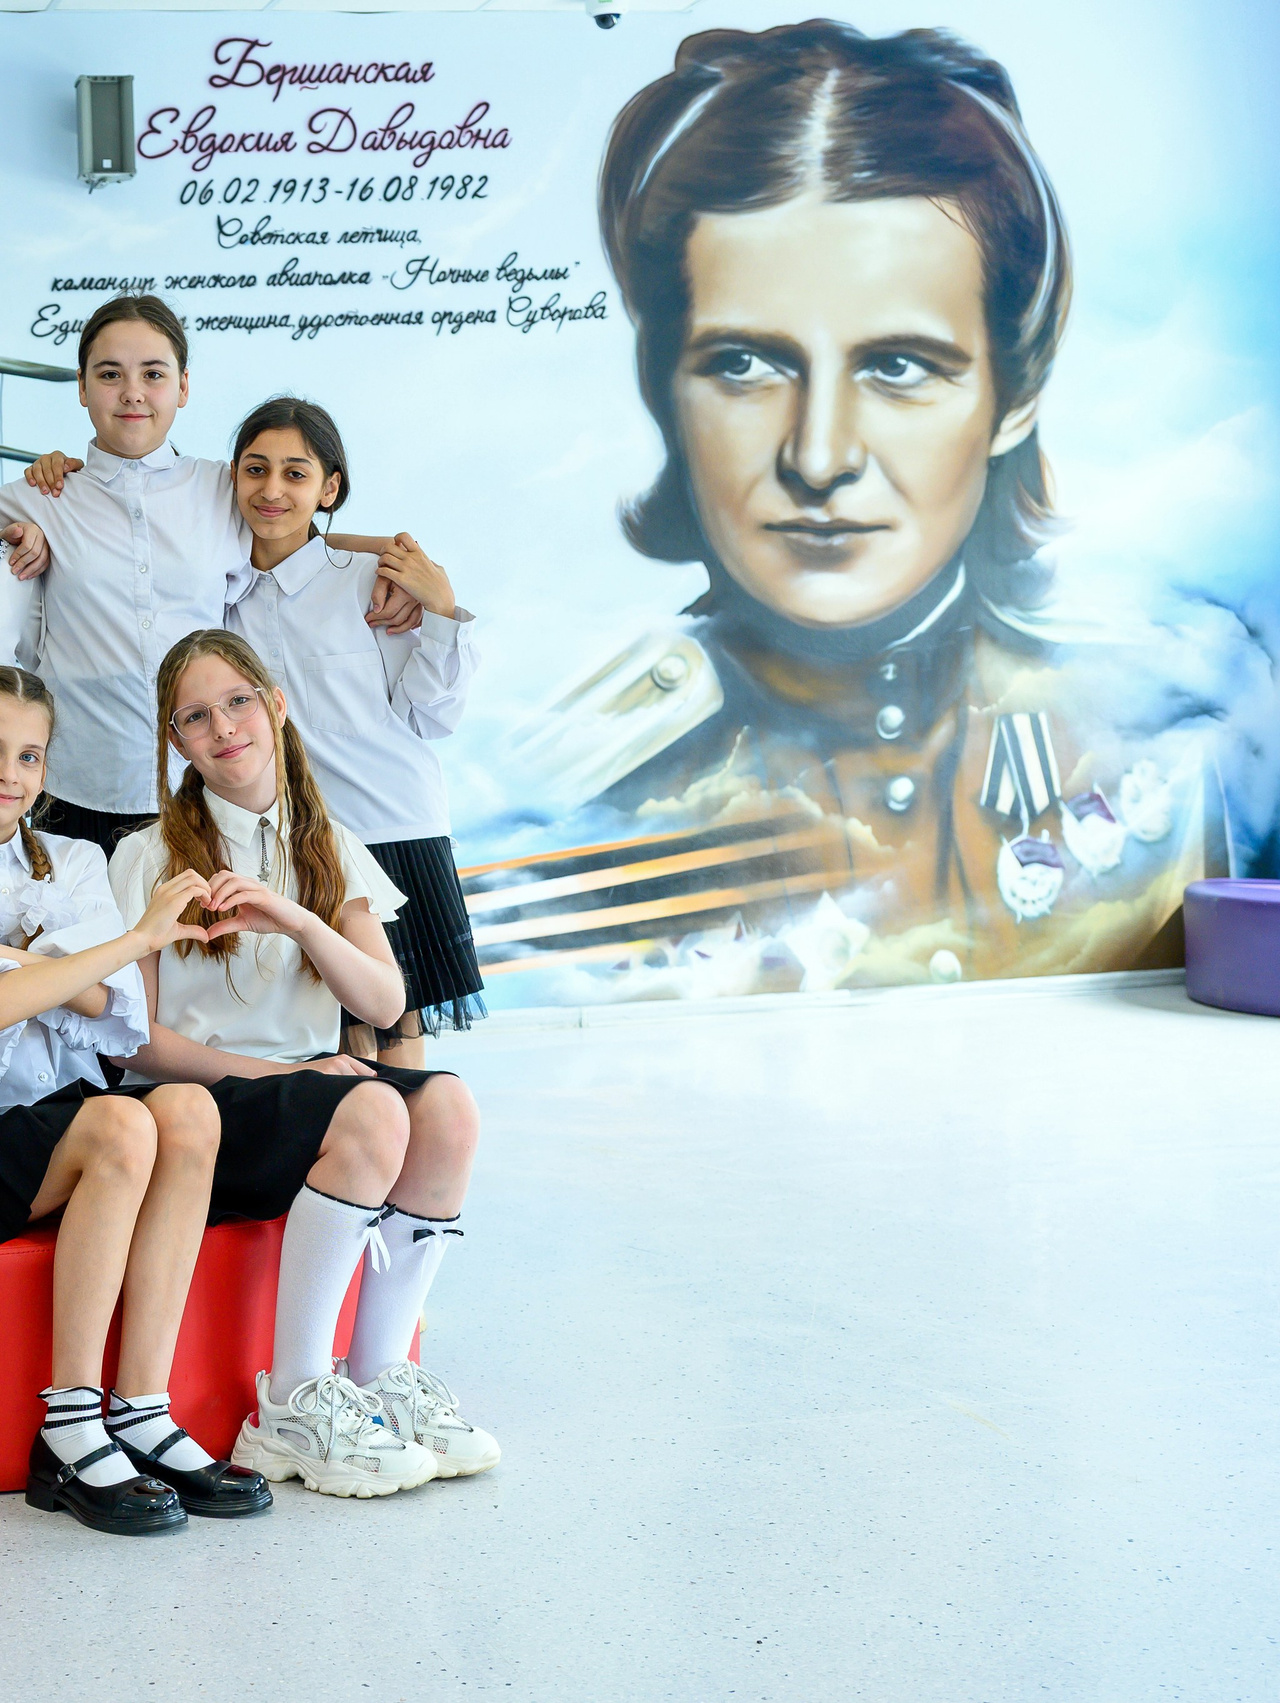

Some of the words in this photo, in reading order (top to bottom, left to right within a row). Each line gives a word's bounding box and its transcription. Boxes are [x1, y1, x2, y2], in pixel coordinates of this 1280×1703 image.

[209, 37, 435, 102] Бершанская
[137, 105, 297, 172] Евдокия
[307, 102, 512, 168] Давыдовна
[217, 215, 330, 249] Советская
[165, 274, 257, 291] женского
[266, 257, 372, 288] авиаполка
[431, 309, 497, 336] ордена
[506, 291, 609, 333] Суворова
